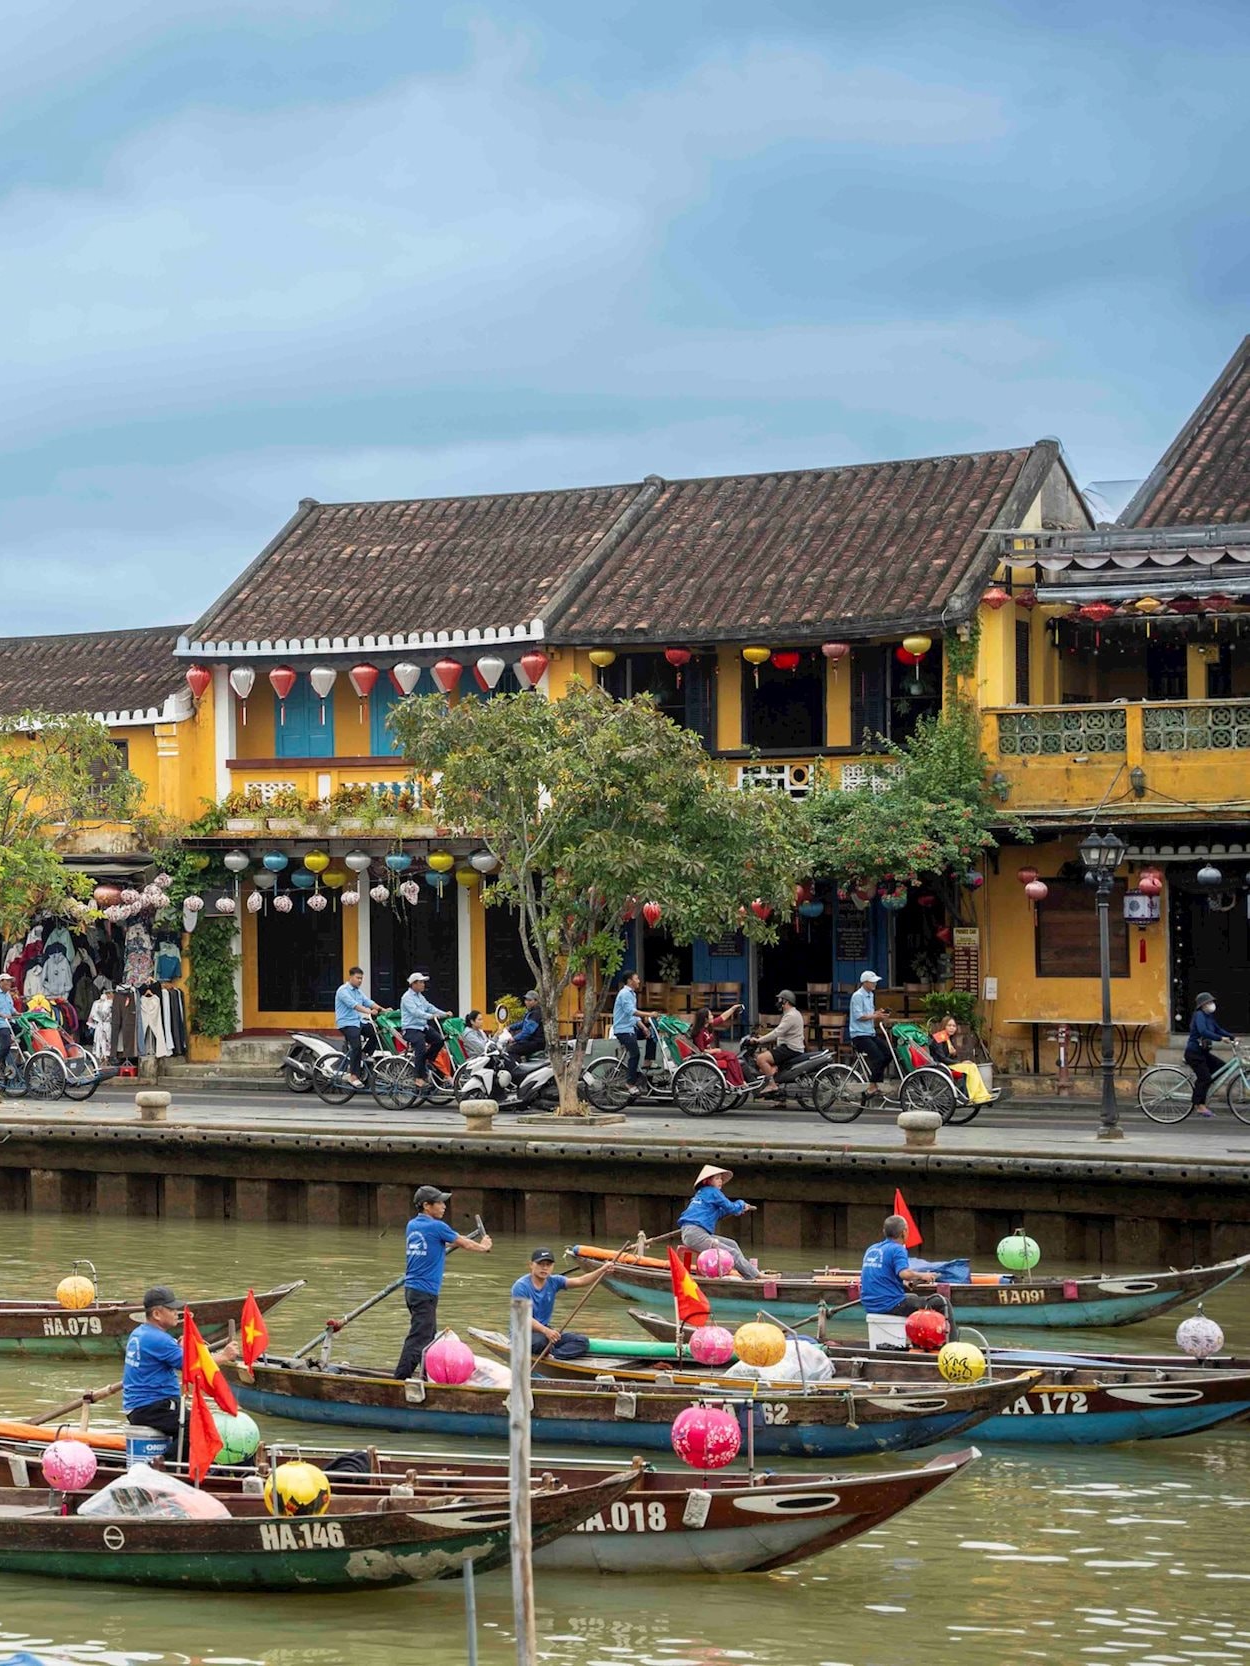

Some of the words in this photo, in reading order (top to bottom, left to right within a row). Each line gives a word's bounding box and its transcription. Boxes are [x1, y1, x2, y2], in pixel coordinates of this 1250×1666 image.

[997, 1289, 1045, 1305] HA091
[42, 1316, 102, 1336] HA.079
[1000, 1396, 1034, 1415] A
[1039, 1392, 1089, 1414] 172
[572, 1501, 667, 1532] A.018
[259, 1521, 346, 1551] HA.146
